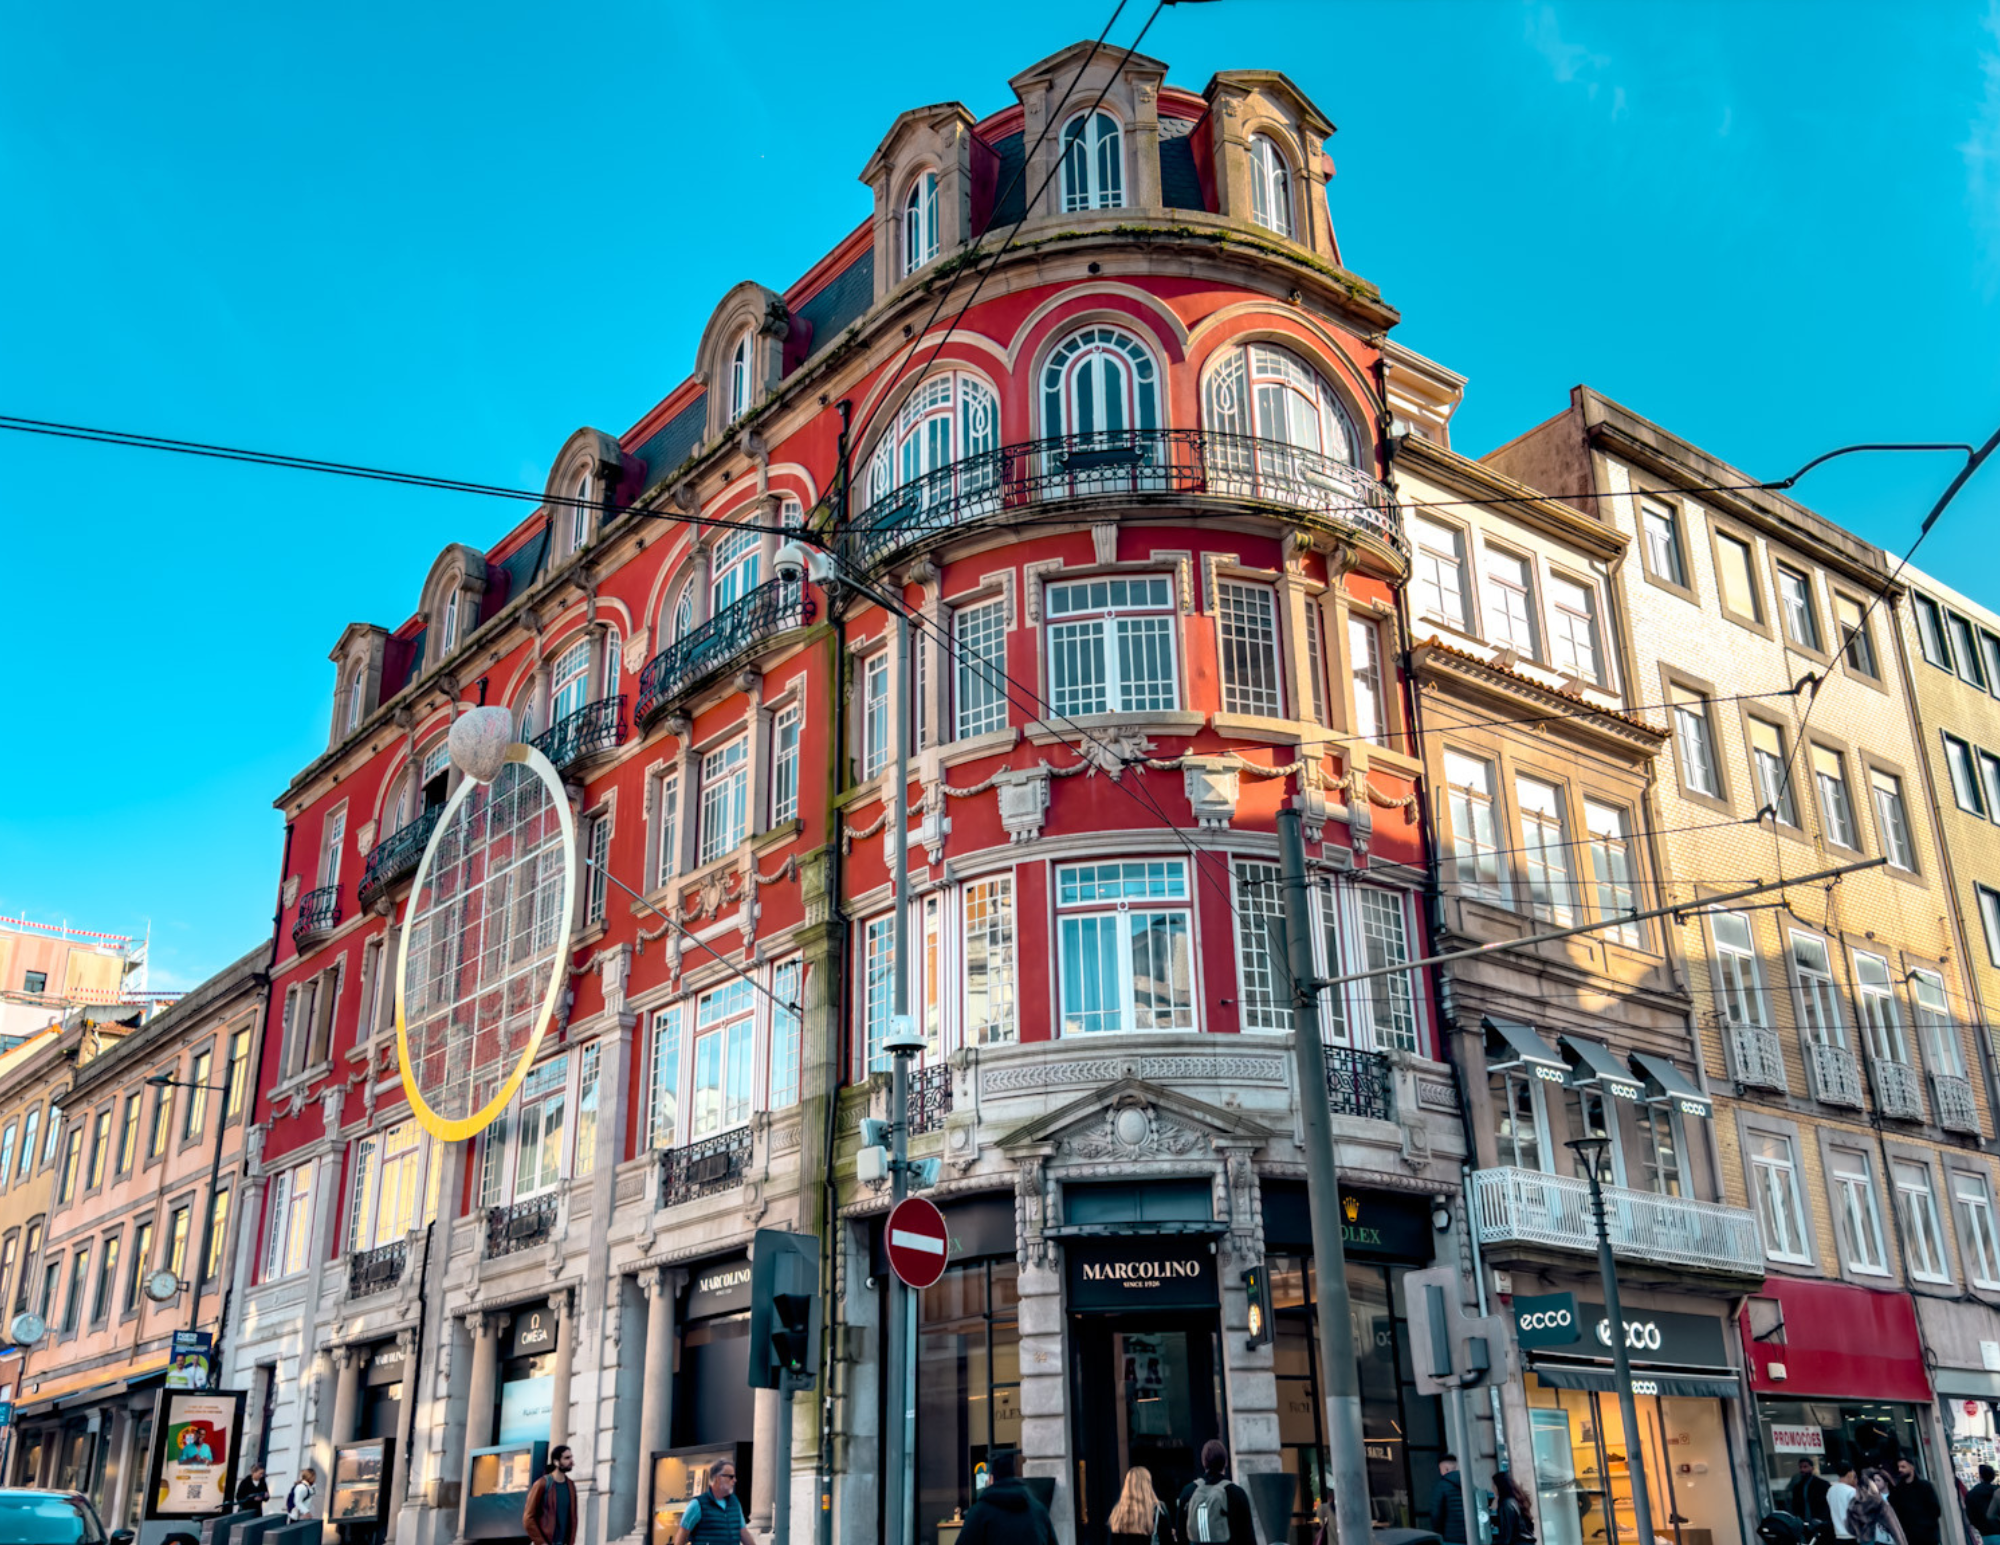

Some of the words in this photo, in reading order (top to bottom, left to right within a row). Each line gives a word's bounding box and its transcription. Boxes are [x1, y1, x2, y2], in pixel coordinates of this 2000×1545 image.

[1535, 1065, 1564, 1084] ecco
[1610, 1083, 1638, 1100] ecco
[1681, 1100, 1706, 1117] ecco
[1341, 1224, 1382, 1245] OLEX
[699, 1268, 752, 1292] MARCOLINO
[1082, 1260, 1201, 1281] MARCOLINO
[1519, 1308, 1572, 1331] ecco
[521, 1329, 548, 1345] OMEGA
[1631, 1380, 1658, 1395] ecco
